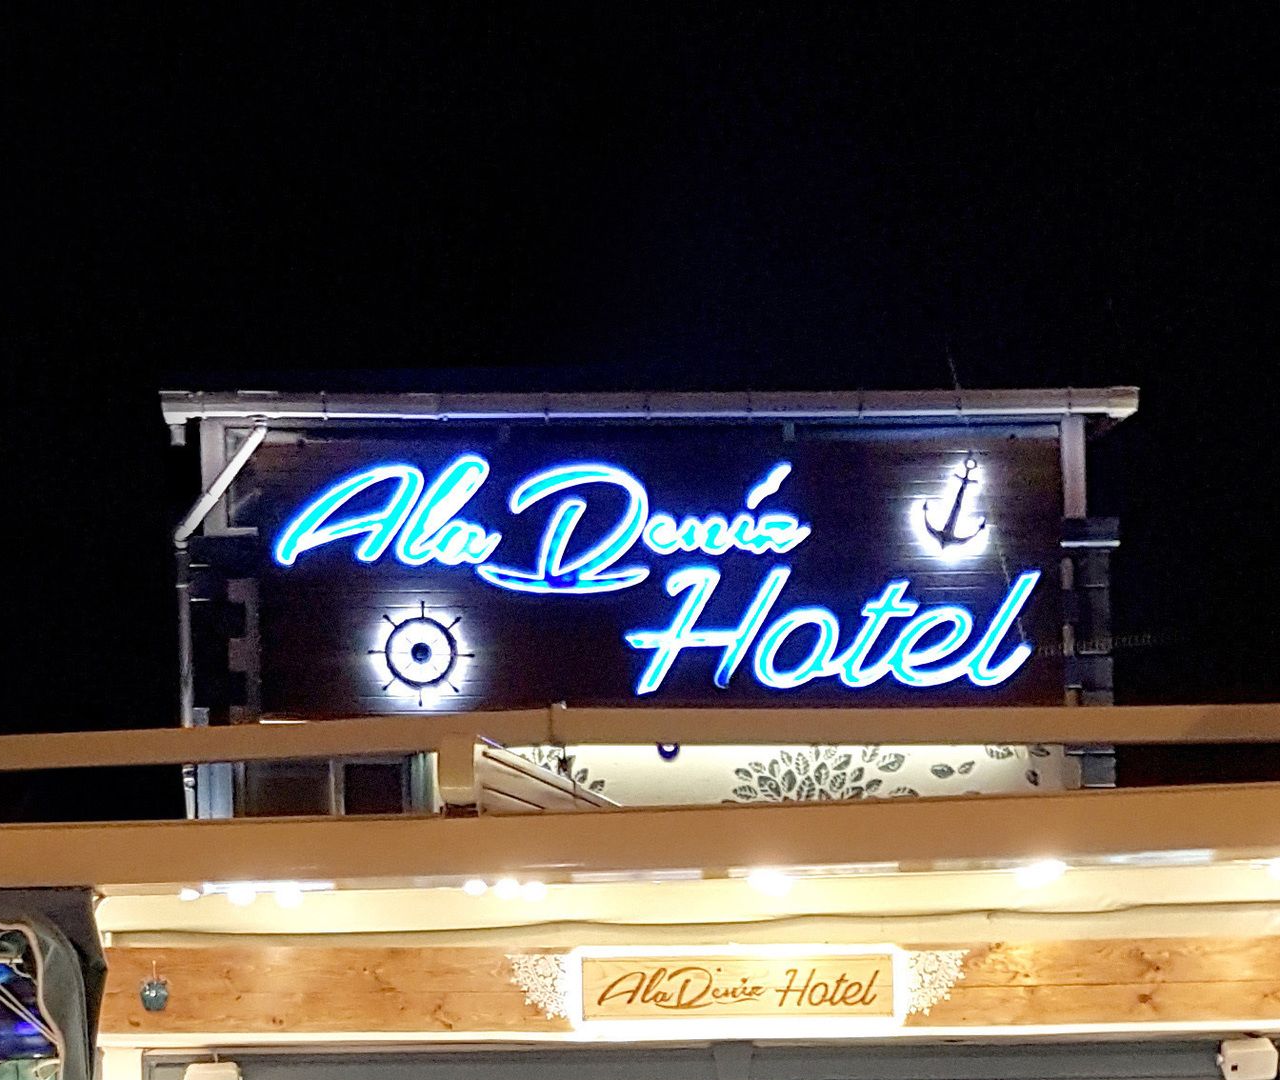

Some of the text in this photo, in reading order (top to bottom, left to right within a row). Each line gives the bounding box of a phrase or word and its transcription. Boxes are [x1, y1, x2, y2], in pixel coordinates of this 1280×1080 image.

[273, 453, 500, 569] Ala
[625, 566, 1042, 697] Hotel
[596, 966, 672, 1006] Ala
[775, 968, 880, 1008] Hotel
